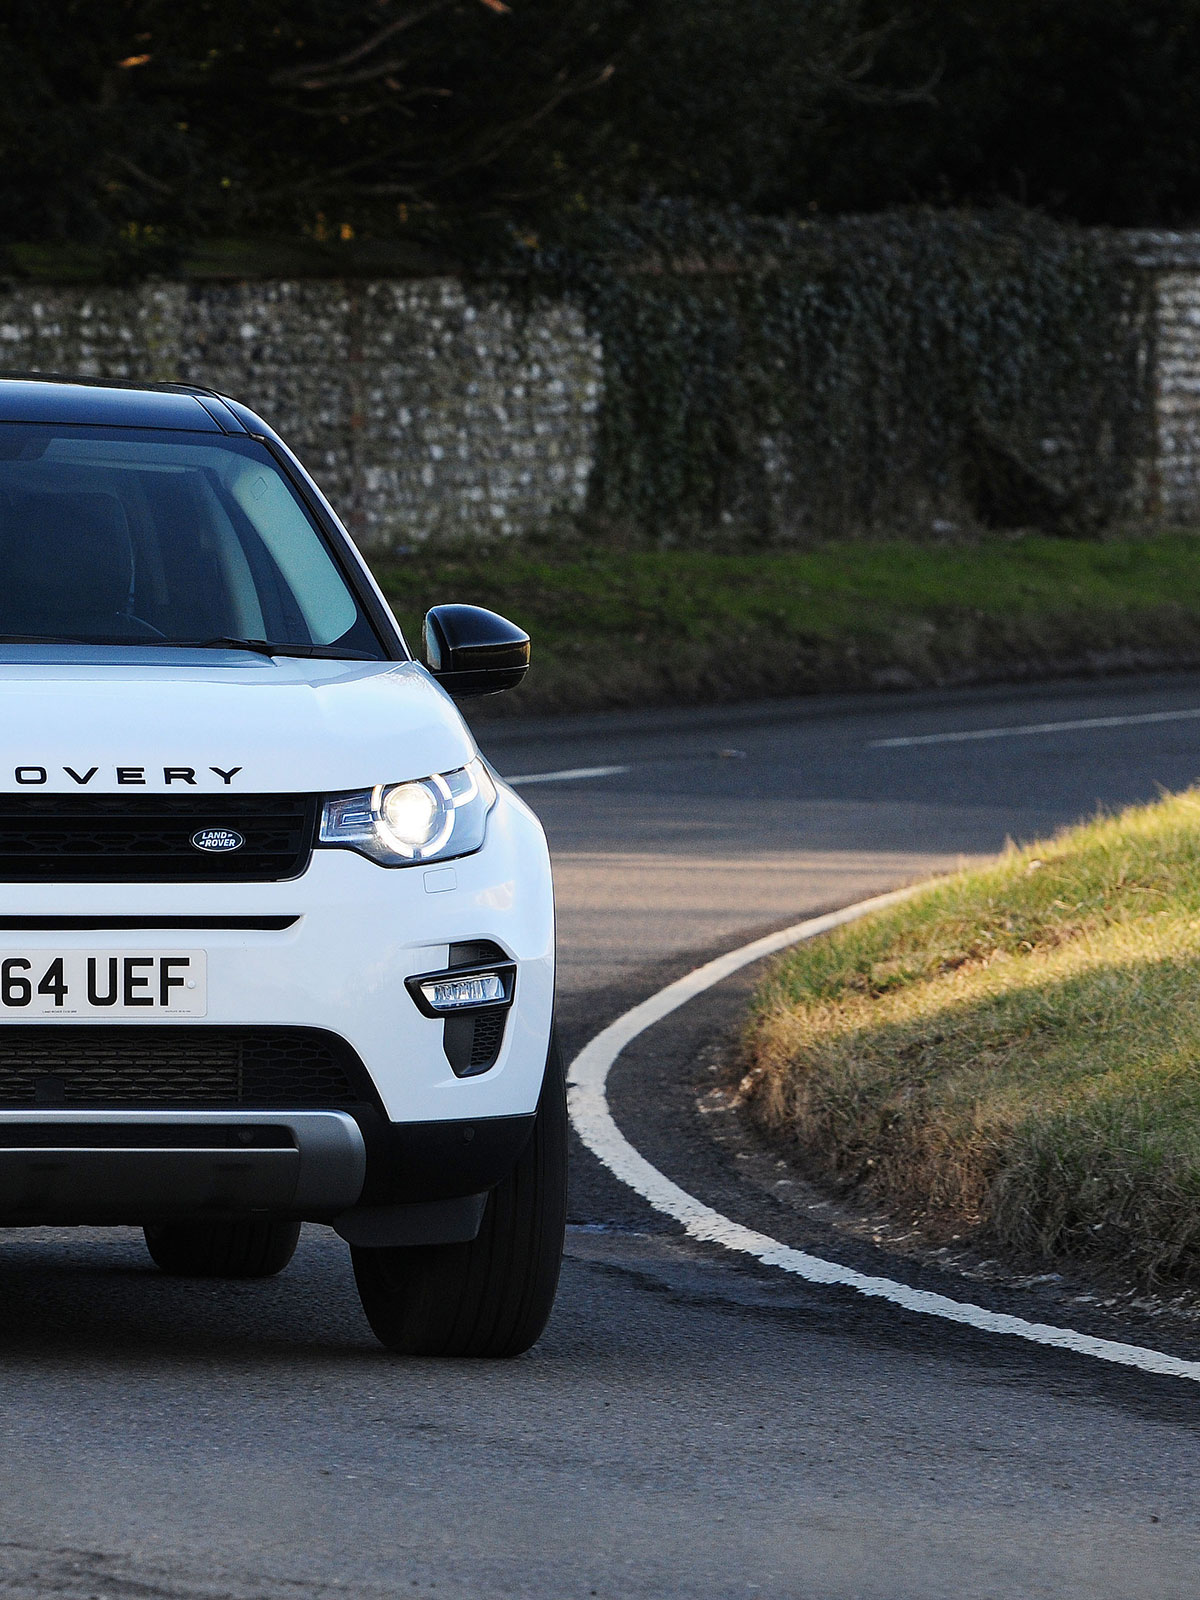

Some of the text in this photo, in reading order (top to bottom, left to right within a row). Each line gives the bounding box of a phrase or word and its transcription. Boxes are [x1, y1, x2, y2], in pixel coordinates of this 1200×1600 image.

[201, 831, 227, 839] LAND
[204, 838, 236, 847] ROVER
[87, 957, 190, 1007] UEF
